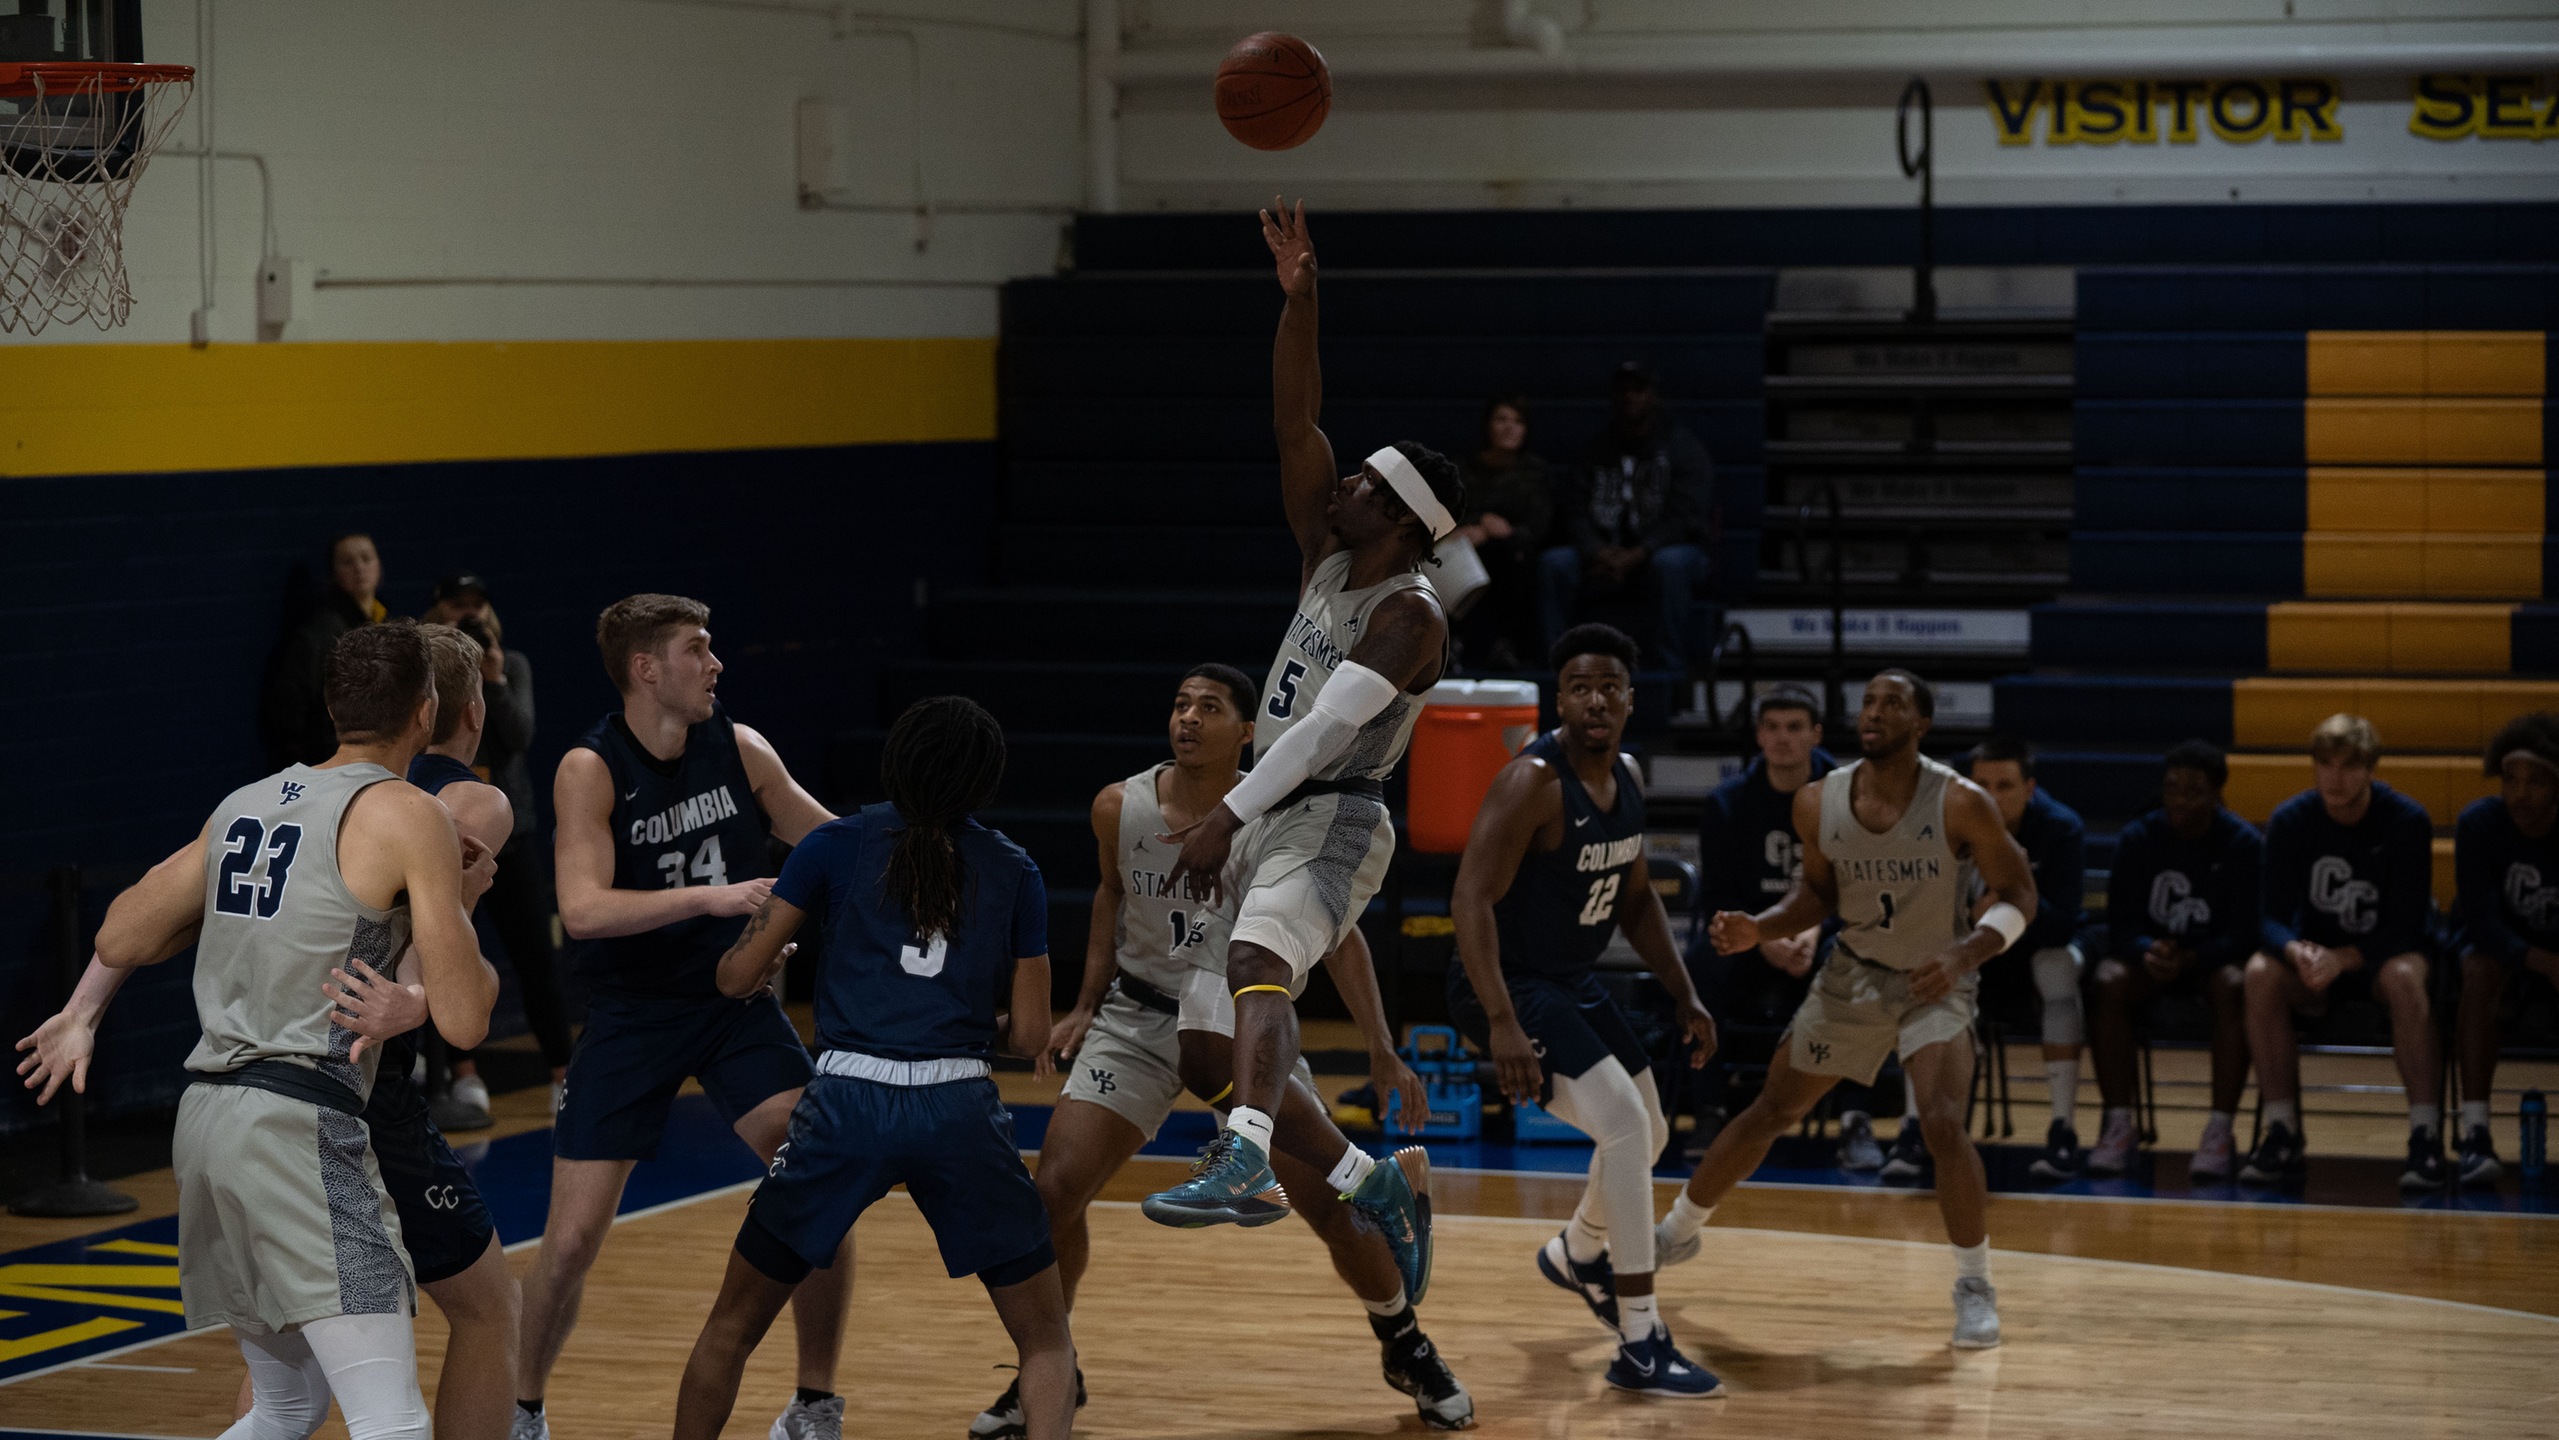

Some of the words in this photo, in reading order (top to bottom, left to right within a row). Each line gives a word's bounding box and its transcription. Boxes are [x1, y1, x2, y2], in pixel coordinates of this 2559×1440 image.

[1985, 78, 2341, 142] VISITOR
[1267, 656, 1309, 721] 5
[630, 785, 738, 845] COLUMBIA
[214, 815, 303, 921] 23
[657, 834, 729, 889] 34
[1579, 872, 1621, 927] 22
[1880, 893, 1894, 929] 1
[424, 1184, 460, 1210] CC
